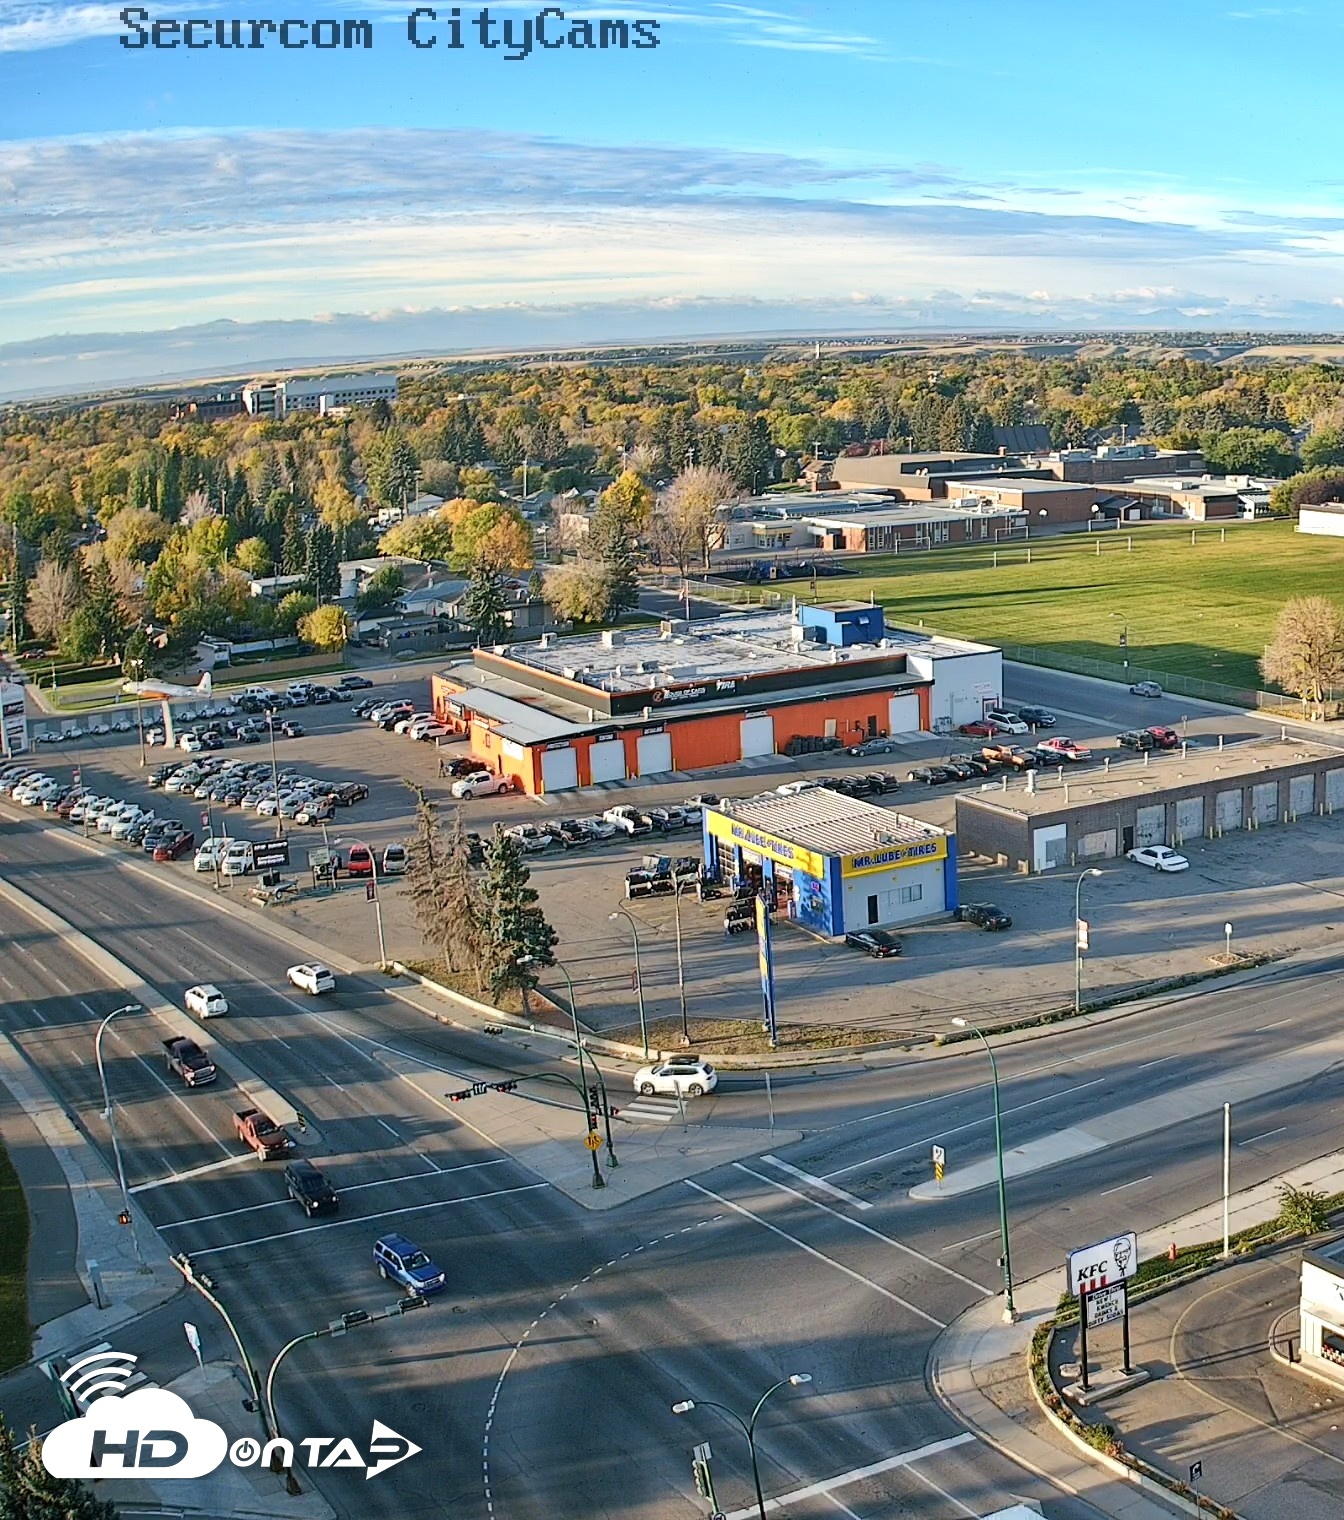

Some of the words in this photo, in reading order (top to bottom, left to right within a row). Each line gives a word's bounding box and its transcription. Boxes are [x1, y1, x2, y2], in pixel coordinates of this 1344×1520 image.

[875, 849, 901, 864] LUBE
[908, 842, 937, 857] TIRES
[1077, 1260, 1108, 1282] KFC
